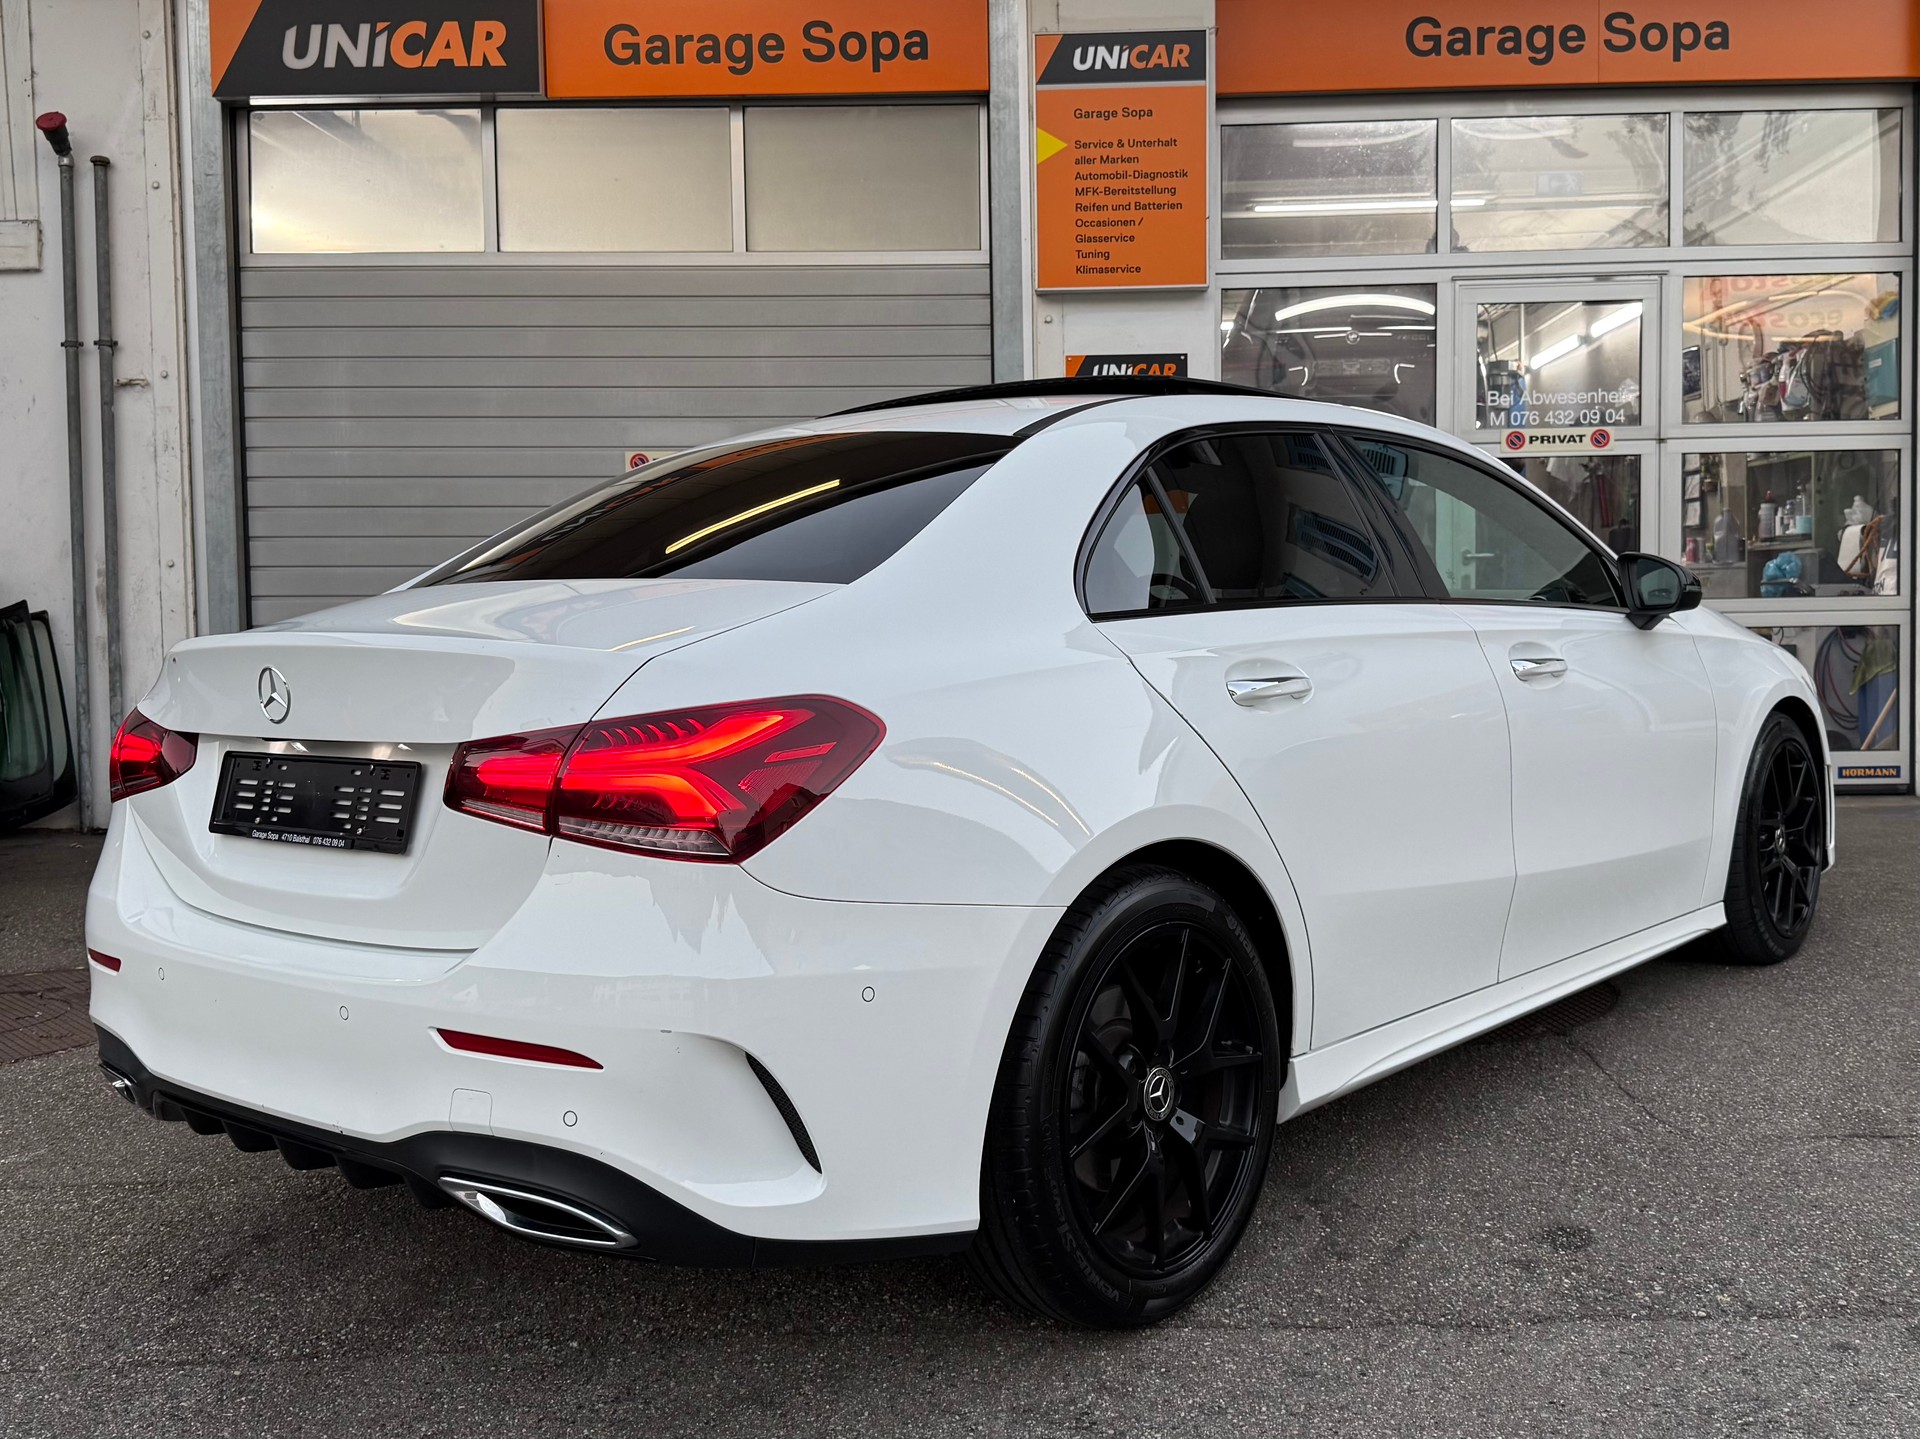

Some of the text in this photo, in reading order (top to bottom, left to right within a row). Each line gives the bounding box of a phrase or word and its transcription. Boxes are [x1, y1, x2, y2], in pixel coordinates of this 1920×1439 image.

[1405, 11, 1730, 66] Garage Sopa
[604, 20, 929, 76] Garage Sopa
[1073, 106, 1154, 121] Garage Sopa
[1074, 137, 1178, 150] Service & Unterhalt
[1074, 155, 1140, 165] aller Marken
[1074, 168, 1189, 181] Automobil-Diagnostik
[1074, 184, 1177, 197] MFK-Bereitstellung
[1075, 200, 1183, 212] Reifen und Batterien
[1075, 217, 1144, 228] Occasionen /
[1075, 233, 1136, 244] Glasservice
[1075, 249, 1110, 261] Tuning
[1075, 264, 1142, 275] Klimaservice
[1487, 390, 1514, 407] Bei
[1490, 408, 1626, 426] M 076 432 09 04
[1528, 434, 1586, 445] PRIVAT
[252, 829, 267, 839] Garage
[267, 831, 279, 841] Sopa
[281, 833, 293, 842] 4710
[312, 836, 322, 845] 076
[322, 837, 331, 846] 432
